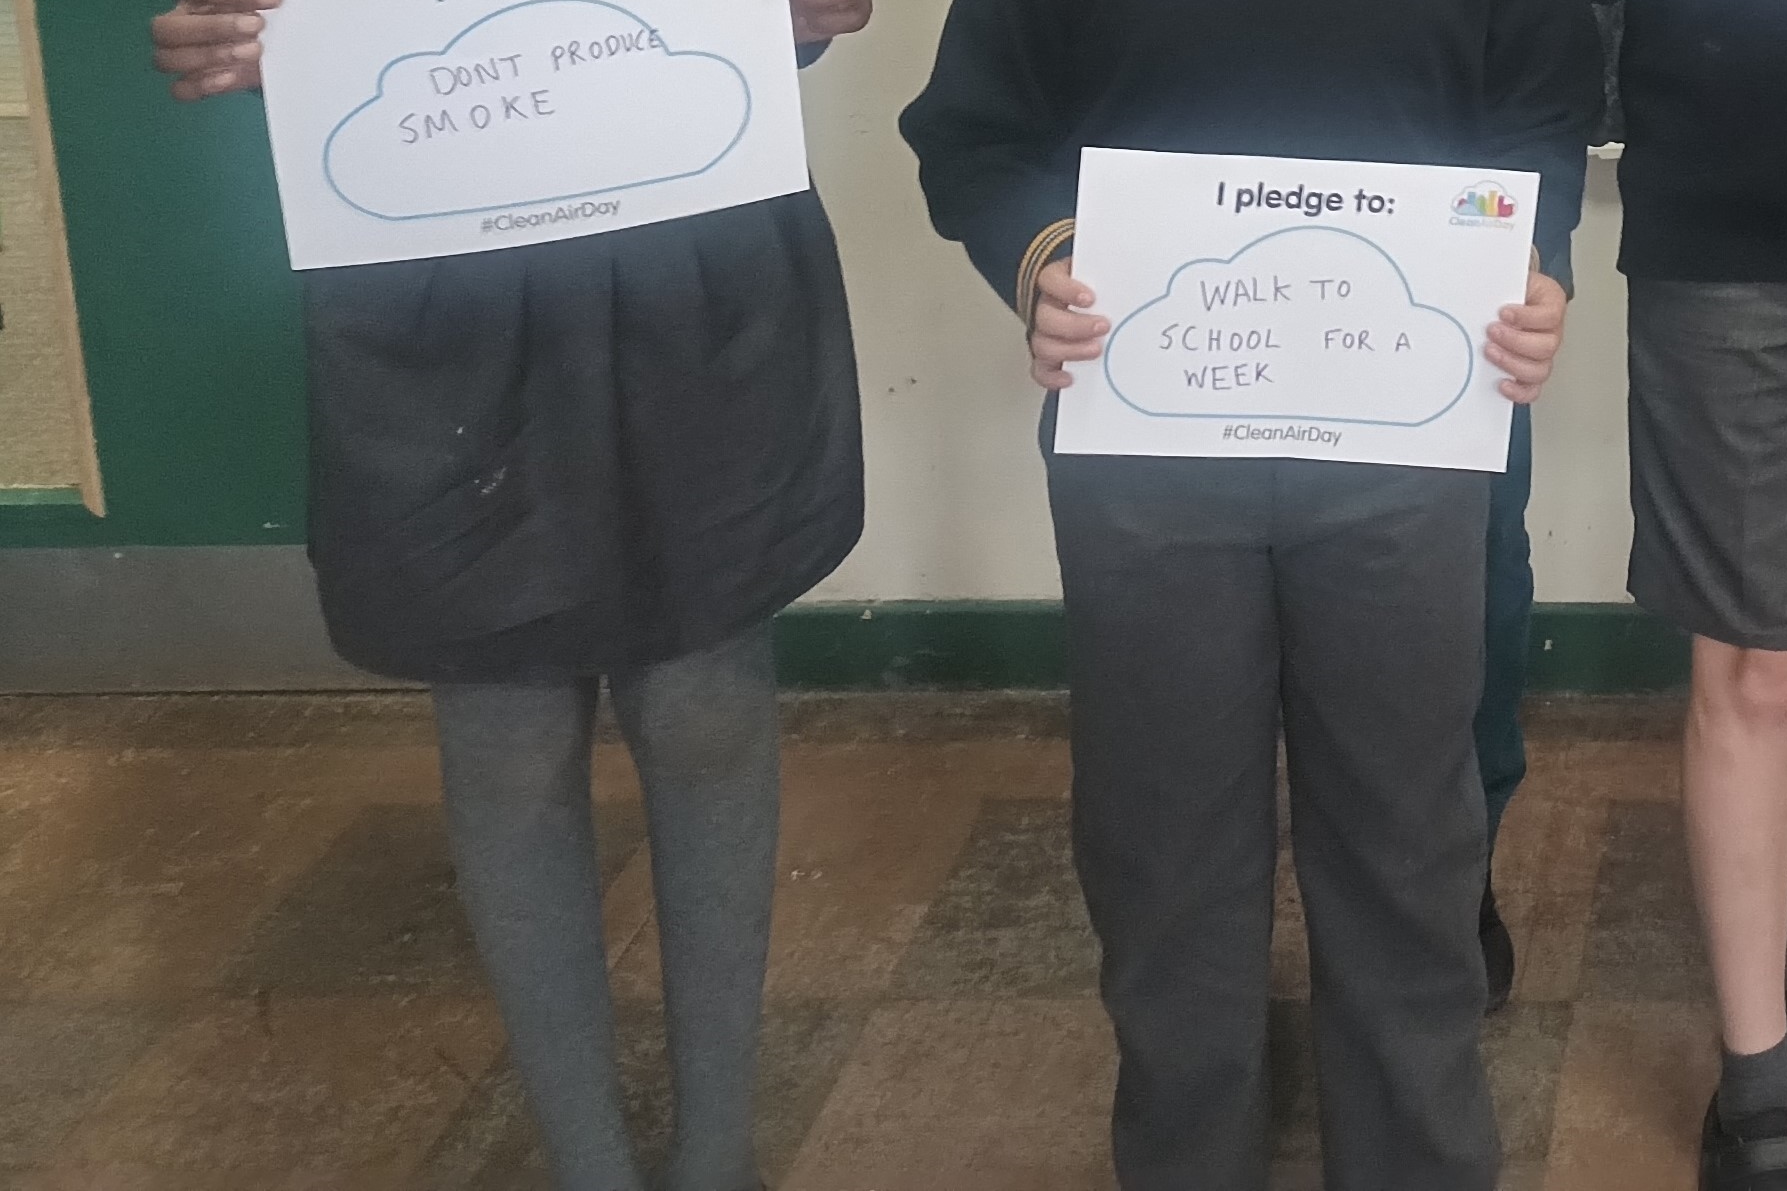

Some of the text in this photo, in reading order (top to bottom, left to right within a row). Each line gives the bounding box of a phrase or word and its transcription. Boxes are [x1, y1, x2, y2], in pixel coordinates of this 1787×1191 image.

[429, 28, 664, 96] DONT PRODUCE
[397, 90, 556, 144] SMOKE
[480, 198, 621, 234] #CleanAirDay
[1216, 182, 1396, 216] I pledge to:
[1200, 275, 1351, 310] WALK TO
[1159, 324, 1411, 353] SCHOOL FOR A
[1184, 362, 1276, 390] WEEK
[1222, 424, 1342, 447] #CleanAirDay
